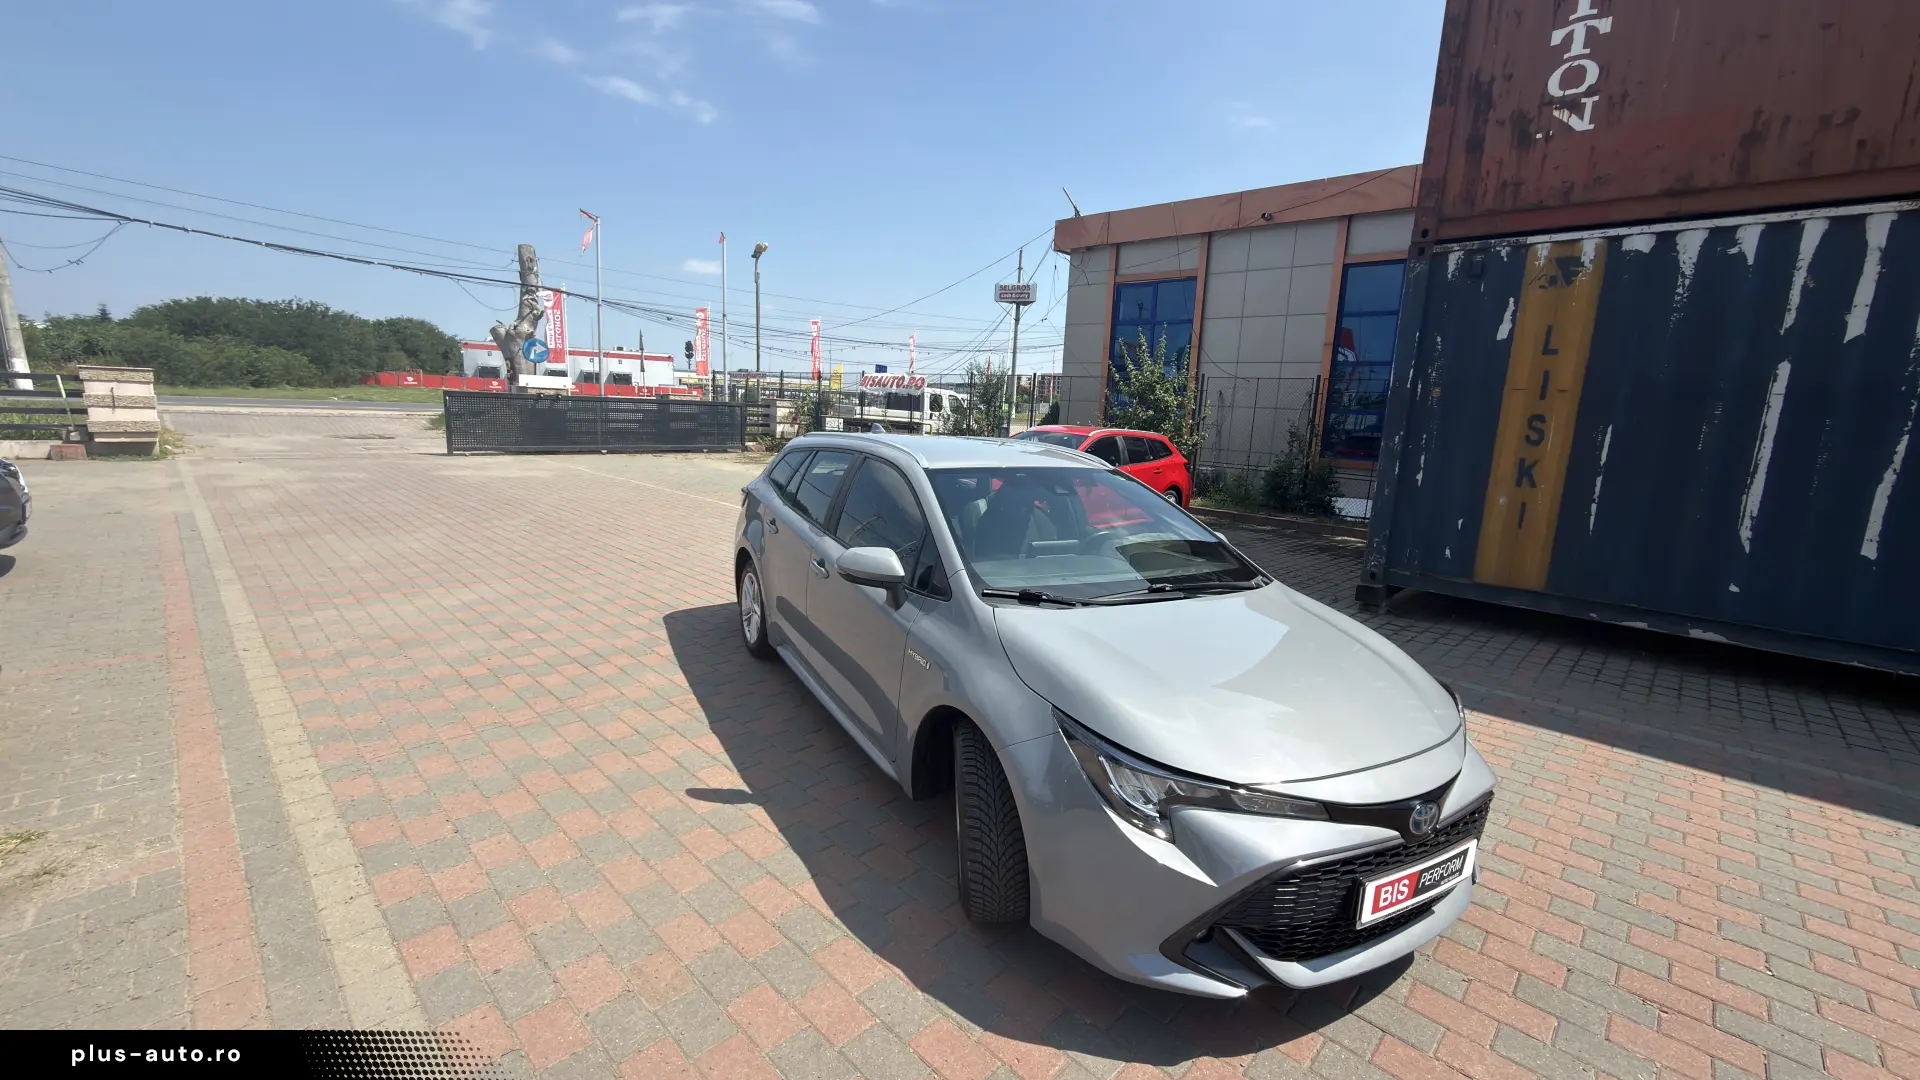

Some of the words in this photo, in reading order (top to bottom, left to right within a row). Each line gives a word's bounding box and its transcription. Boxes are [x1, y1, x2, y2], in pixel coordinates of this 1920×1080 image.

[999, 284, 1031, 292] SELGROS
[860, 374, 925, 391] BISAUTO.RO
[1515, 324, 1559, 530] LISKI
[908, 648, 927, 667] HYBRID
[1378, 878, 1410, 908] BIS
[1418, 855, 1464, 888] PERFORM
